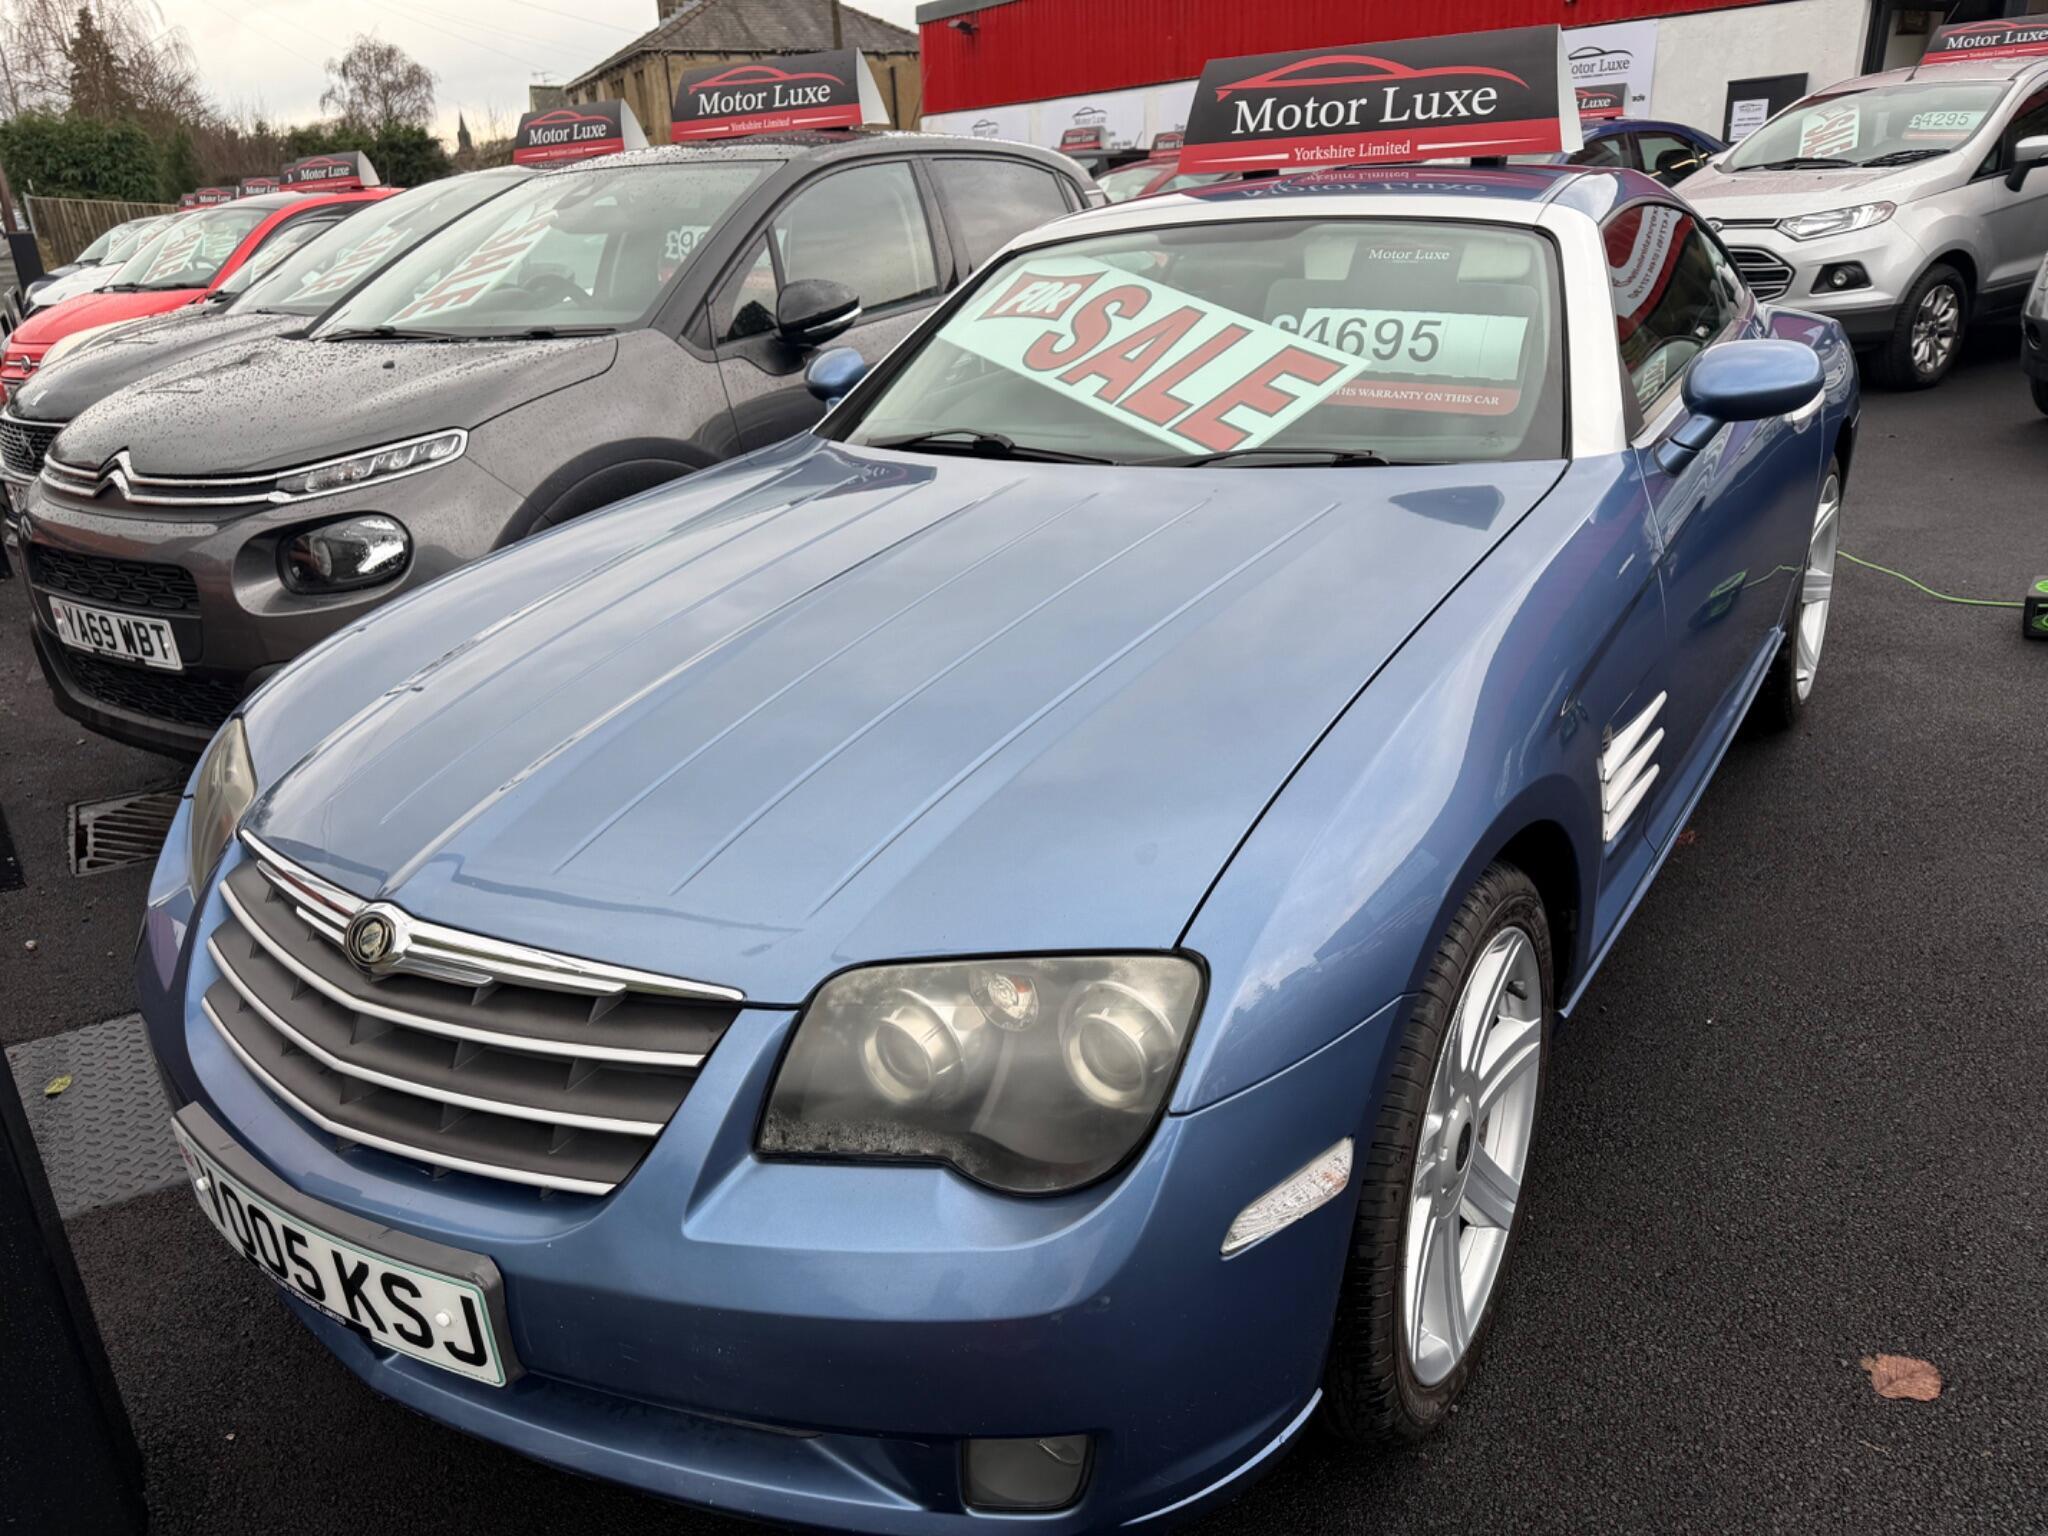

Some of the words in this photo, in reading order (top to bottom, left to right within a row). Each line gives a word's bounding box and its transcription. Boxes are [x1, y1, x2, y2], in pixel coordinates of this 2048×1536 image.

[1946, 34, 2000, 50] Motor
[2004, 29, 2048, 44] Luxe
[1569, 61, 1597, 75] otor
[1599, 58, 1630, 72] Luxe
[697, 92, 767, 116] Motor
[773, 84, 831, 108] Luxe
[1231, 96, 1367, 135] Motor
[1380, 85, 1498, 123] Luxe
[1581, 98, 1611, 109] Luxe
[730, 120, 762, 132] Yorkshire
[763, 116, 790, 128] Limited
[1908, 112, 1971, 128] £4295
[528, 128, 570, 146] Motor
[572, 123, 607, 140] Luxe
[1294, 145, 1356, 161] Yorkshire
[1359, 140, 1411, 158] Limited
[301, 168, 327, 181] Motor
[328, 165, 350, 178] Luxe
[1368, 249, 1411, 260] Motor
[1415, 249, 1449, 260] Luxe
[993, 280, 1083, 314] FOR
[1021, 283, 1350, 454] SALE
[1358, 388, 1423, 400] WARRANTY
[1425, 392, 1444, 401] ON
[1445, 393, 1472, 403] THIS
[1474, 396, 1499, 406] CAR
[63, 605, 116, 650] YA69
[117, 618, 168, 660] WBT
[331, 1250, 488, 1368] KSJ
